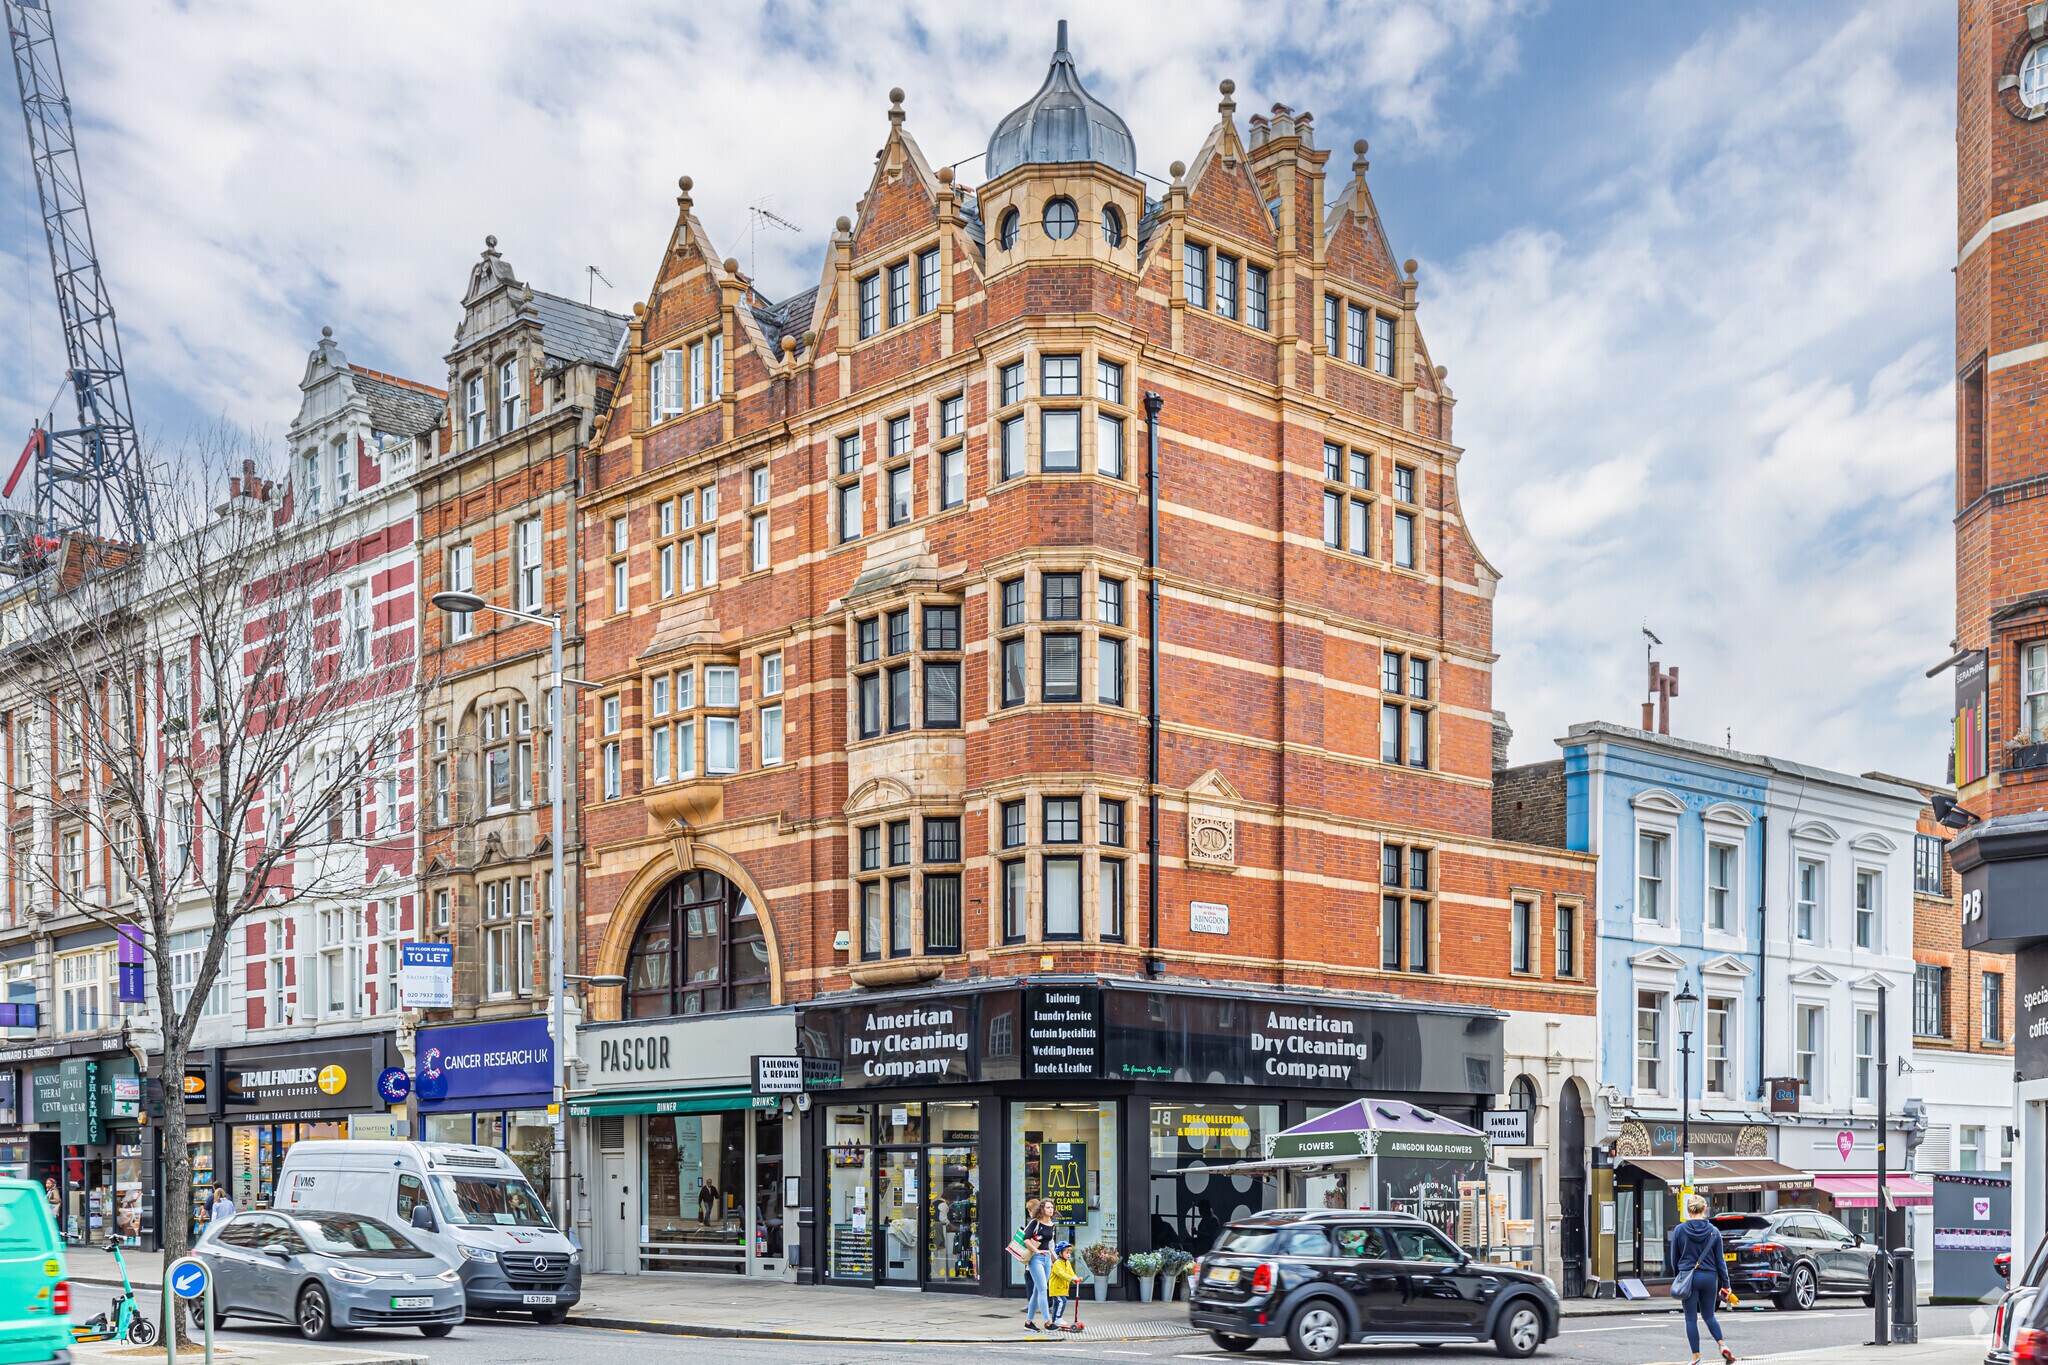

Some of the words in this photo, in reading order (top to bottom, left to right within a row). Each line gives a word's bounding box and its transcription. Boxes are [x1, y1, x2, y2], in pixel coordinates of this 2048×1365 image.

[1956, 661, 1984, 684] SERAPHINE
[1962, 889, 1982, 924] PB
[1194, 916, 1226, 924] ABINGDON
[408, 952, 423, 962] TO
[426, 954, 448, 962] LET
[1046, 993, 1080, 1004] Tailoring
[866, 1009, 953, 1031] American
[1034, 1010, 1065, 1022] Laundry
[1066, 1010, 1092, 1020] Service
[1267, 1011, 1353, 1034] American
[1030, 1028, 1057, 1038] Curtain
[1058, 1028, 1096, 1039] Specialists
[102, 1040, 118, 1049] HAIR
[850, 1038, 881, 1056] Dry
[884, 1031, 968, 1052] Cleaning
[1252, 1033, 1284, 1054] Dry
[1287, 1036, 1367, 1060] Cleaning
[23, 1050, 26, 1059] &
[28, 1047, 55, 1058] SLINGSBY
[601, 1036, 670, 1072] PASCOR
[1032, 1046, 1066, 1057] Wedding
[1067, 1046, 1094, 1055] Dresses
[444, 1054, 481, 1070] CANCER
[484, 1050, 532, 1066] RESEARCH
[534, 1049, 548, 1063] UK
[68, 1066, 78, 1074] THE
[864, 1058, 950, 1077] Company
[1034, 1063, 1057, 1073] Suede
[1058, 1064, 1063, 1073] &
[1064, 1063, 1092, 1073] Leather
[1266, 1058, 1351, 1080] Company
[35, 1075, 60, 1085] KENSING
[241, 1068, 317, 1087] TRAILFINDERS
[63, 1080, 83, 1089] PESTLE
[259, 1089, 283, 1097] TRAVEL
[288, 1087, 318, 1095] EXPERTS
[1775, 1089, 1795, 1104] Raj
[656, 1102, 677, 1112] DINNER
[752, 1097, 774, 1106] DRINKS
[62, 1103, 86, 1112] MORTAR
[89, 1076, 97, 1142] PHARMACY
[570, 1107, 590, 1115] BRUNCH
[300, 1110, 320, 1118] CRUISE
[1182, 1115, 1200, 1124] FREE
[1202, 1115, 1244, 1124] COLLECTION
[1177, 1128, 1183, 1136] &
[1184, 1128, 1220, 1136] DELIVERY
[1221, 1128, 1249, 1136] SERVICE
[1654, 1125, 1677, 1153] Raj
[1299, 1142, 1334, 1150] FLOWERS
[1392, 1142, 1425, 1152] ABINGDON
[1426, 1144, 1443, 1152] ROAD
[1444, 1144, 1472, 1154] FLOWERS
[300, 1177, 315, 1187] VMS
[1410, 1182, 1438, 1194] ABIGDON
[1441, 1184, 1453, 1194] ROA
